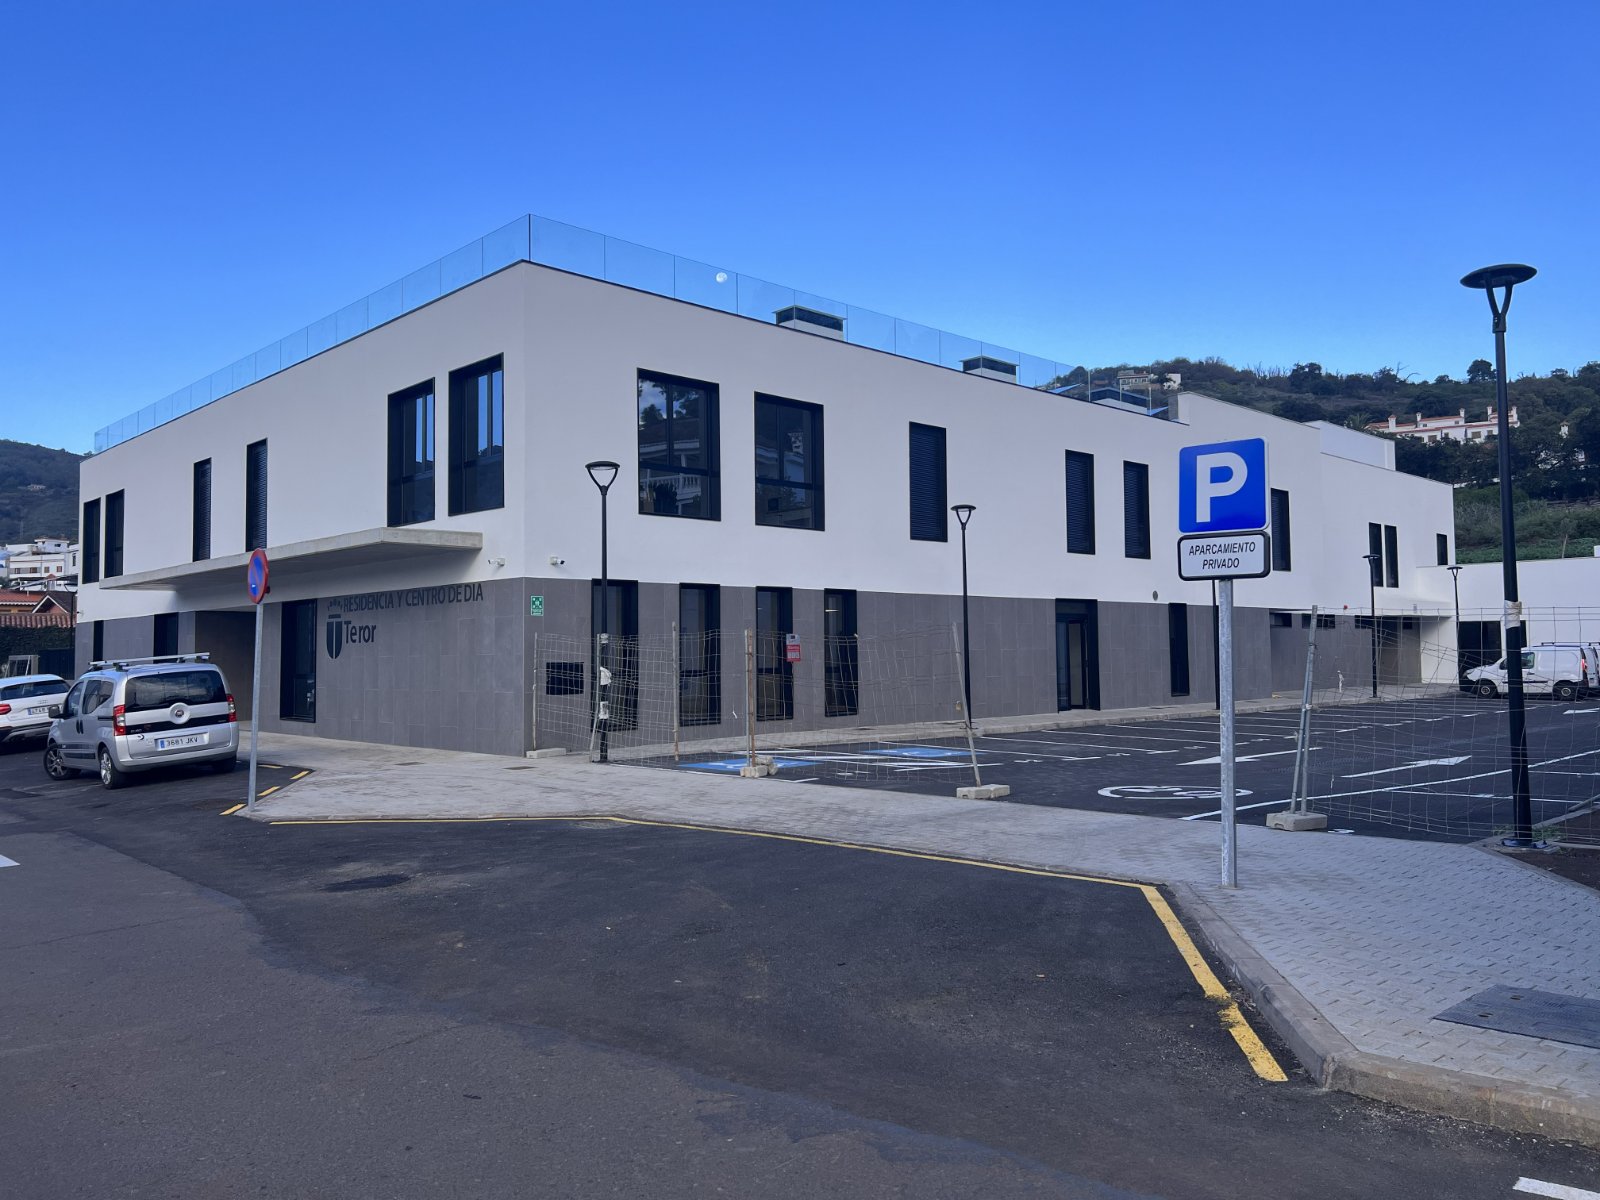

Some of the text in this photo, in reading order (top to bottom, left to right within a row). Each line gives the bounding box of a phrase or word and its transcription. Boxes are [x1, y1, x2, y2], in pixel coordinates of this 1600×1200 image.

[1196, 451, 1248, 523] P
[1189, 541, 1256, 556] APARCAMIENTO
[1202, 557, 1240, 570] PRIVADO
[343, 592, 394, 613] RESIDENCIA
[397, 591, 403, 608] Y
[405, 586, 446, 607] CENTRO
[448, 584, 462, 603] DE
[343, 620, 377, 645] Teror
